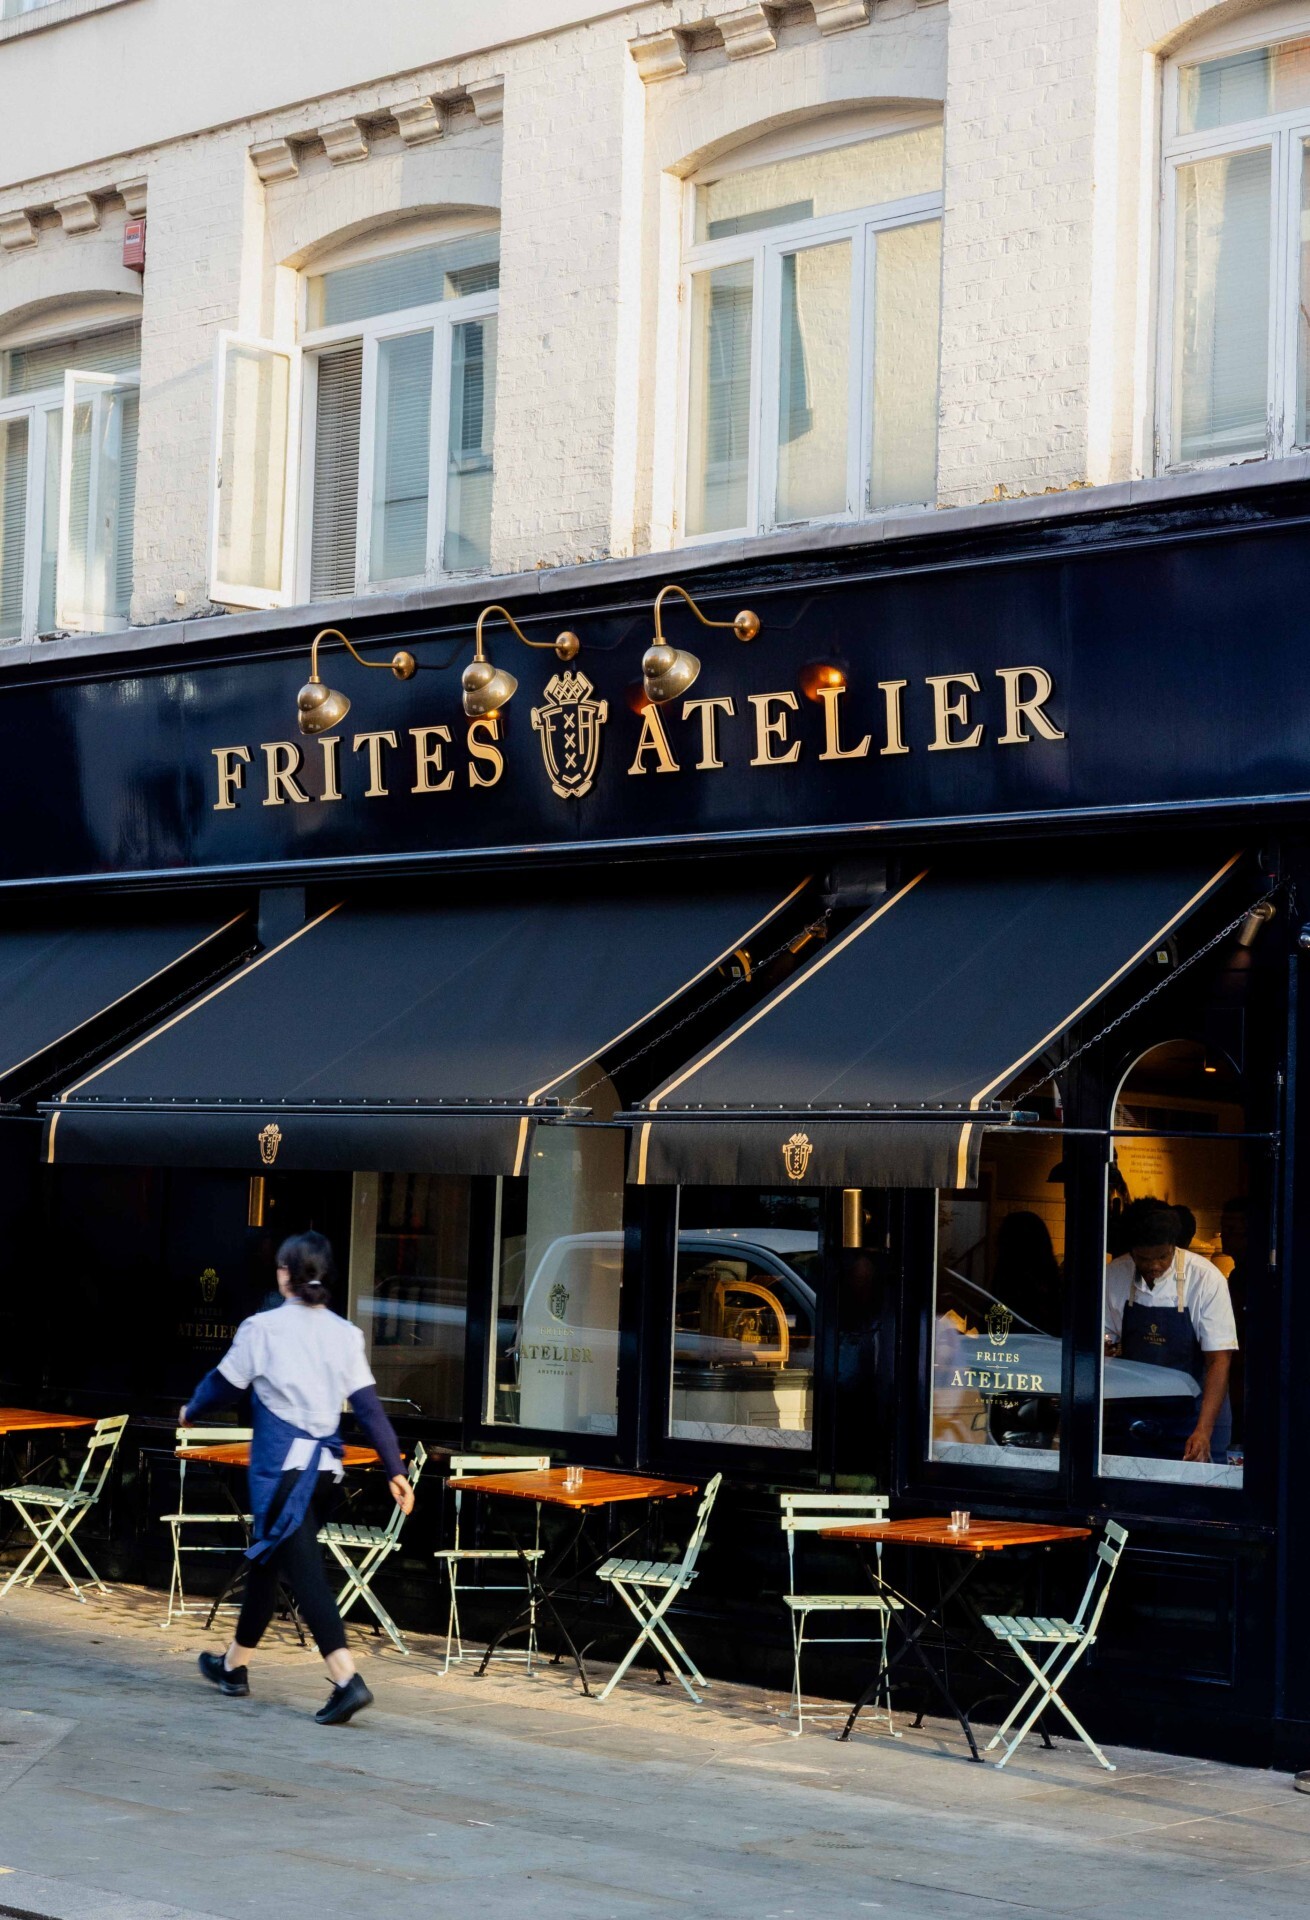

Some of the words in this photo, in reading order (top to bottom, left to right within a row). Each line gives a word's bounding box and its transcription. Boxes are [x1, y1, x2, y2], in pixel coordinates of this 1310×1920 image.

[211, 719, 504, 810] FRITES
[628, 666, 1066, 775] ATELIER
[540, 1327, 575, 1336] FRITES
[520, 1344, 594, 1363] ATELIER
[976, 1351, 1020, 1363] FRITES
[951, 1370, 1044, 1391] ATELIER
